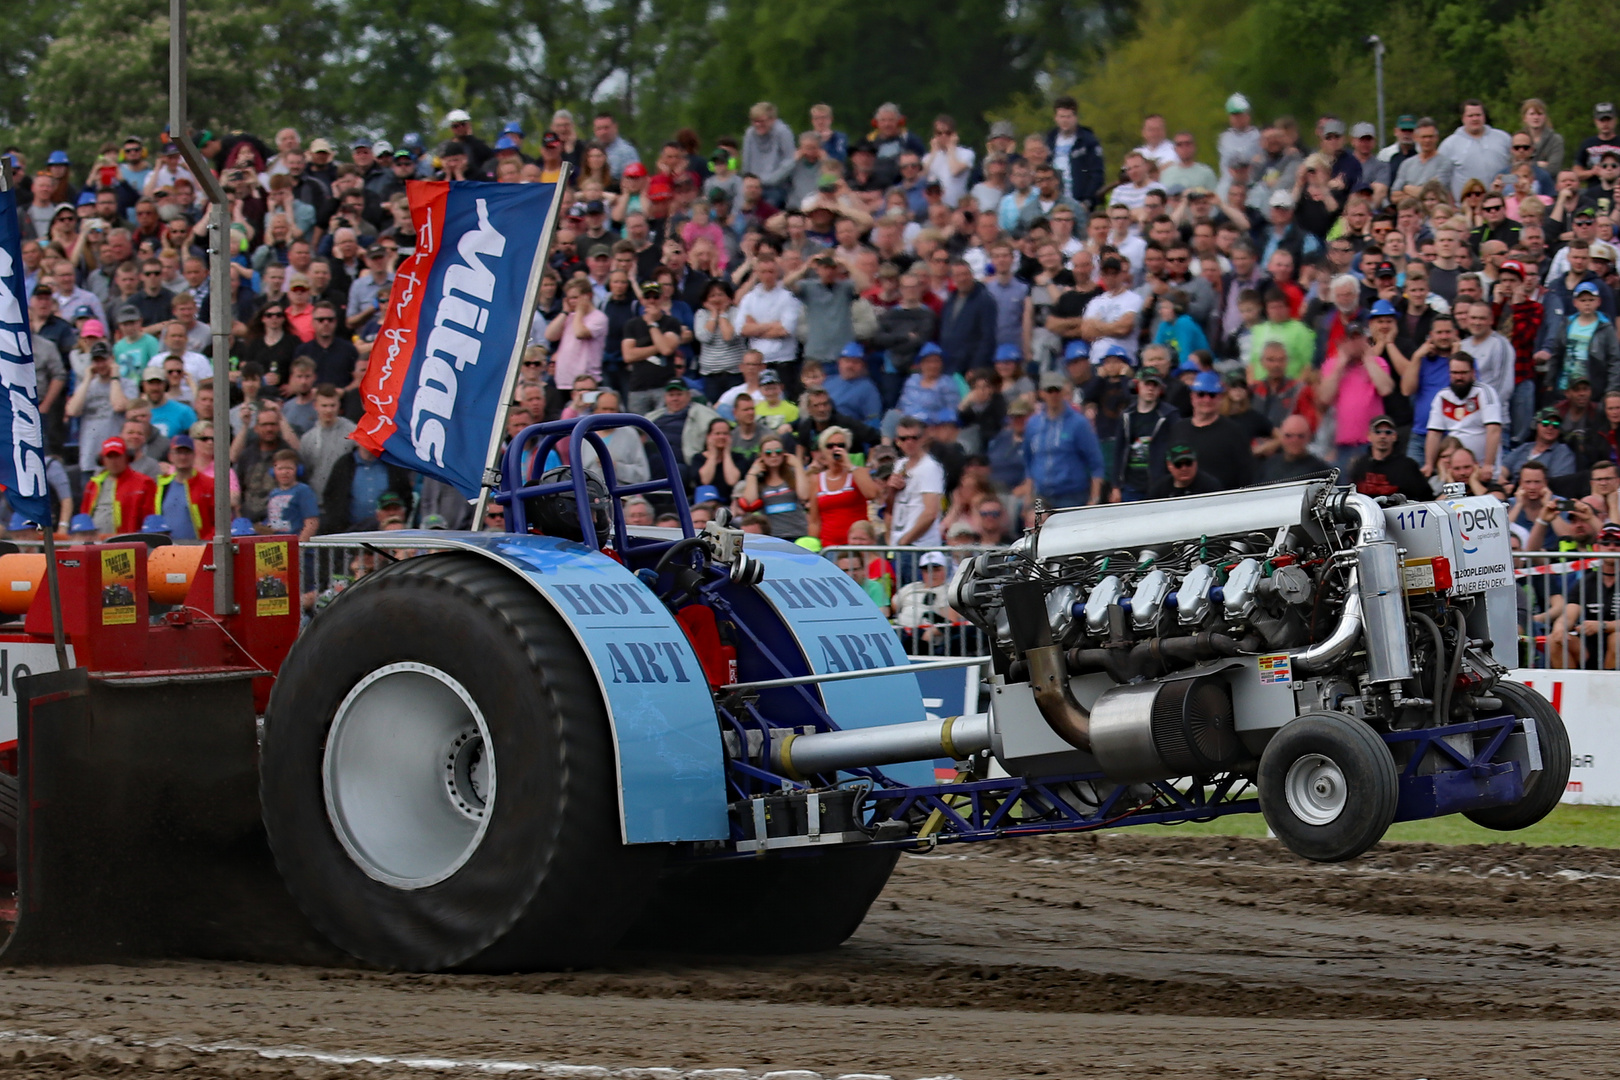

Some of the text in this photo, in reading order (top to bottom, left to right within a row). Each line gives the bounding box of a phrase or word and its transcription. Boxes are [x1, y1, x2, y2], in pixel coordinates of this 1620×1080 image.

[398, 272, 421, 319] for
[410, 198, 506, 469] Mitas
[1397, 509, 1428, 531] 117
[551, 583, 655, 615] HOT
[763, 576, 864, 609] HOT
[606, 642, 691, 683] ART
[817, 632, 893, 673] ART
